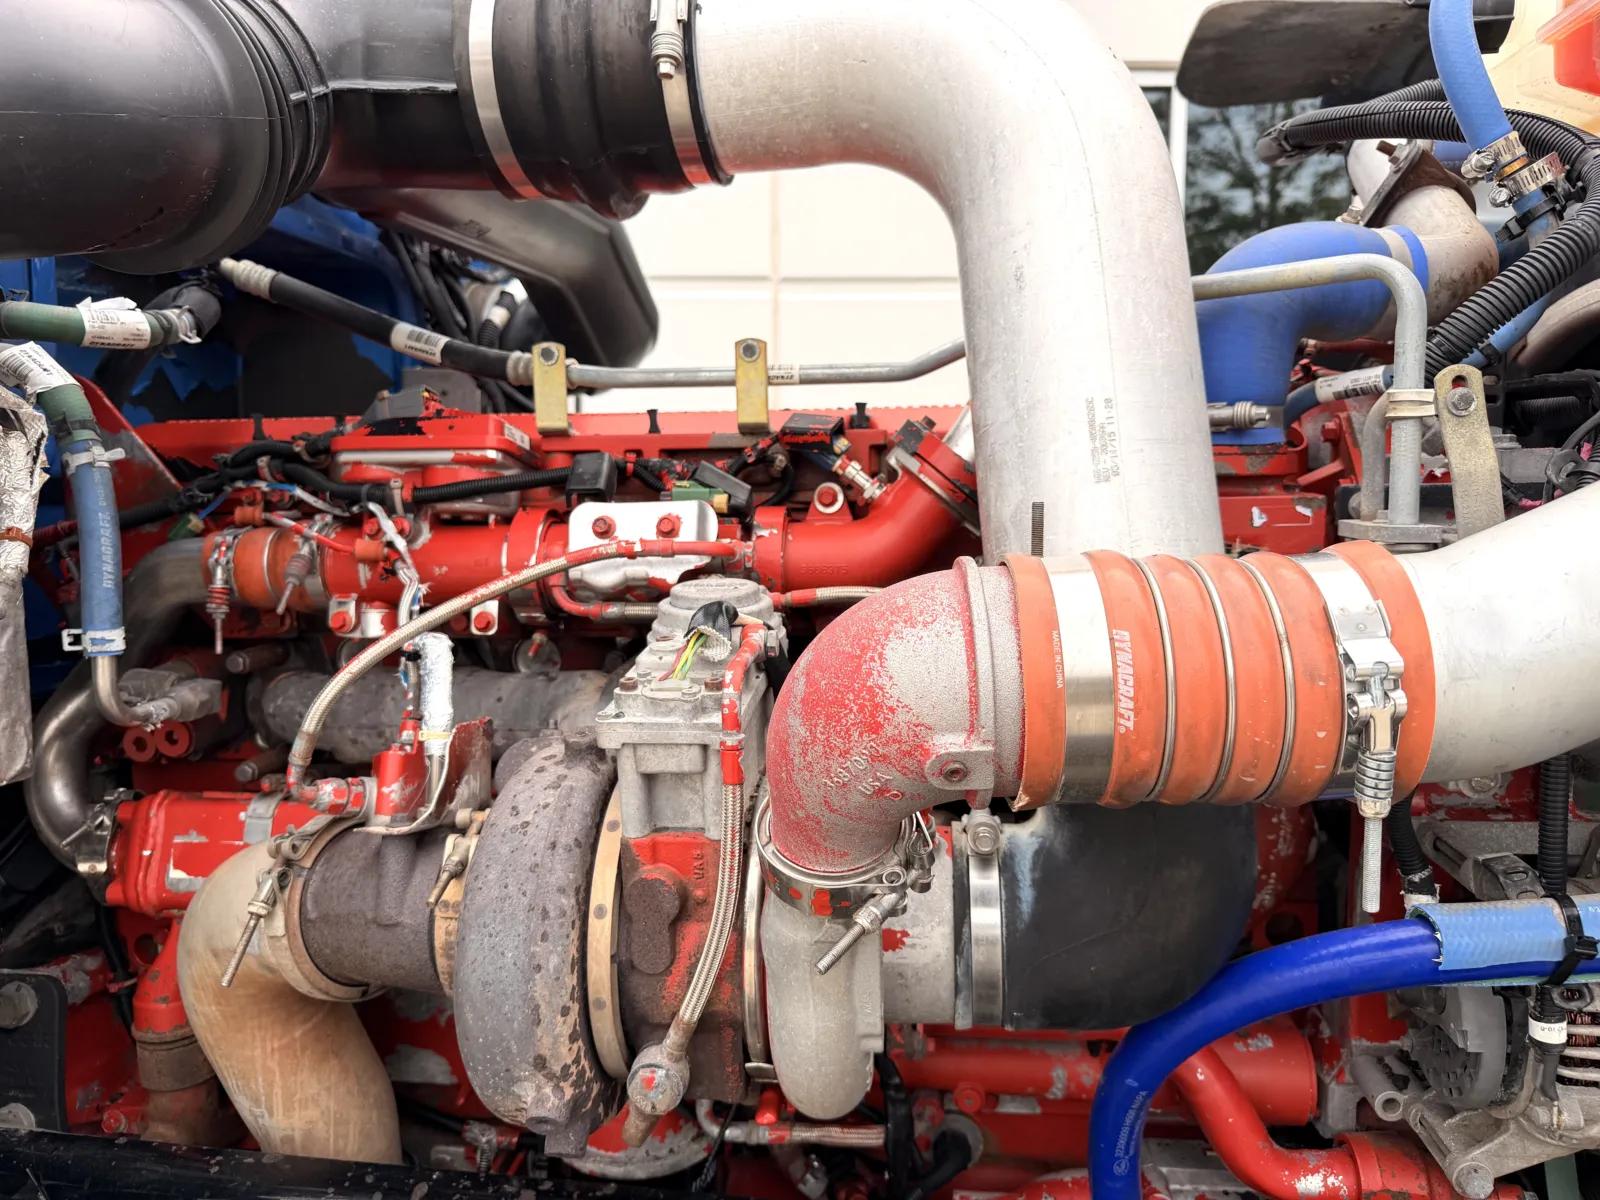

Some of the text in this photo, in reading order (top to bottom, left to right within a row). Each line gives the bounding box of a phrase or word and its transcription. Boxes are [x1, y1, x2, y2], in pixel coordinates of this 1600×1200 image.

[1051, 630, 1064, 688] MADE IN CHINA
